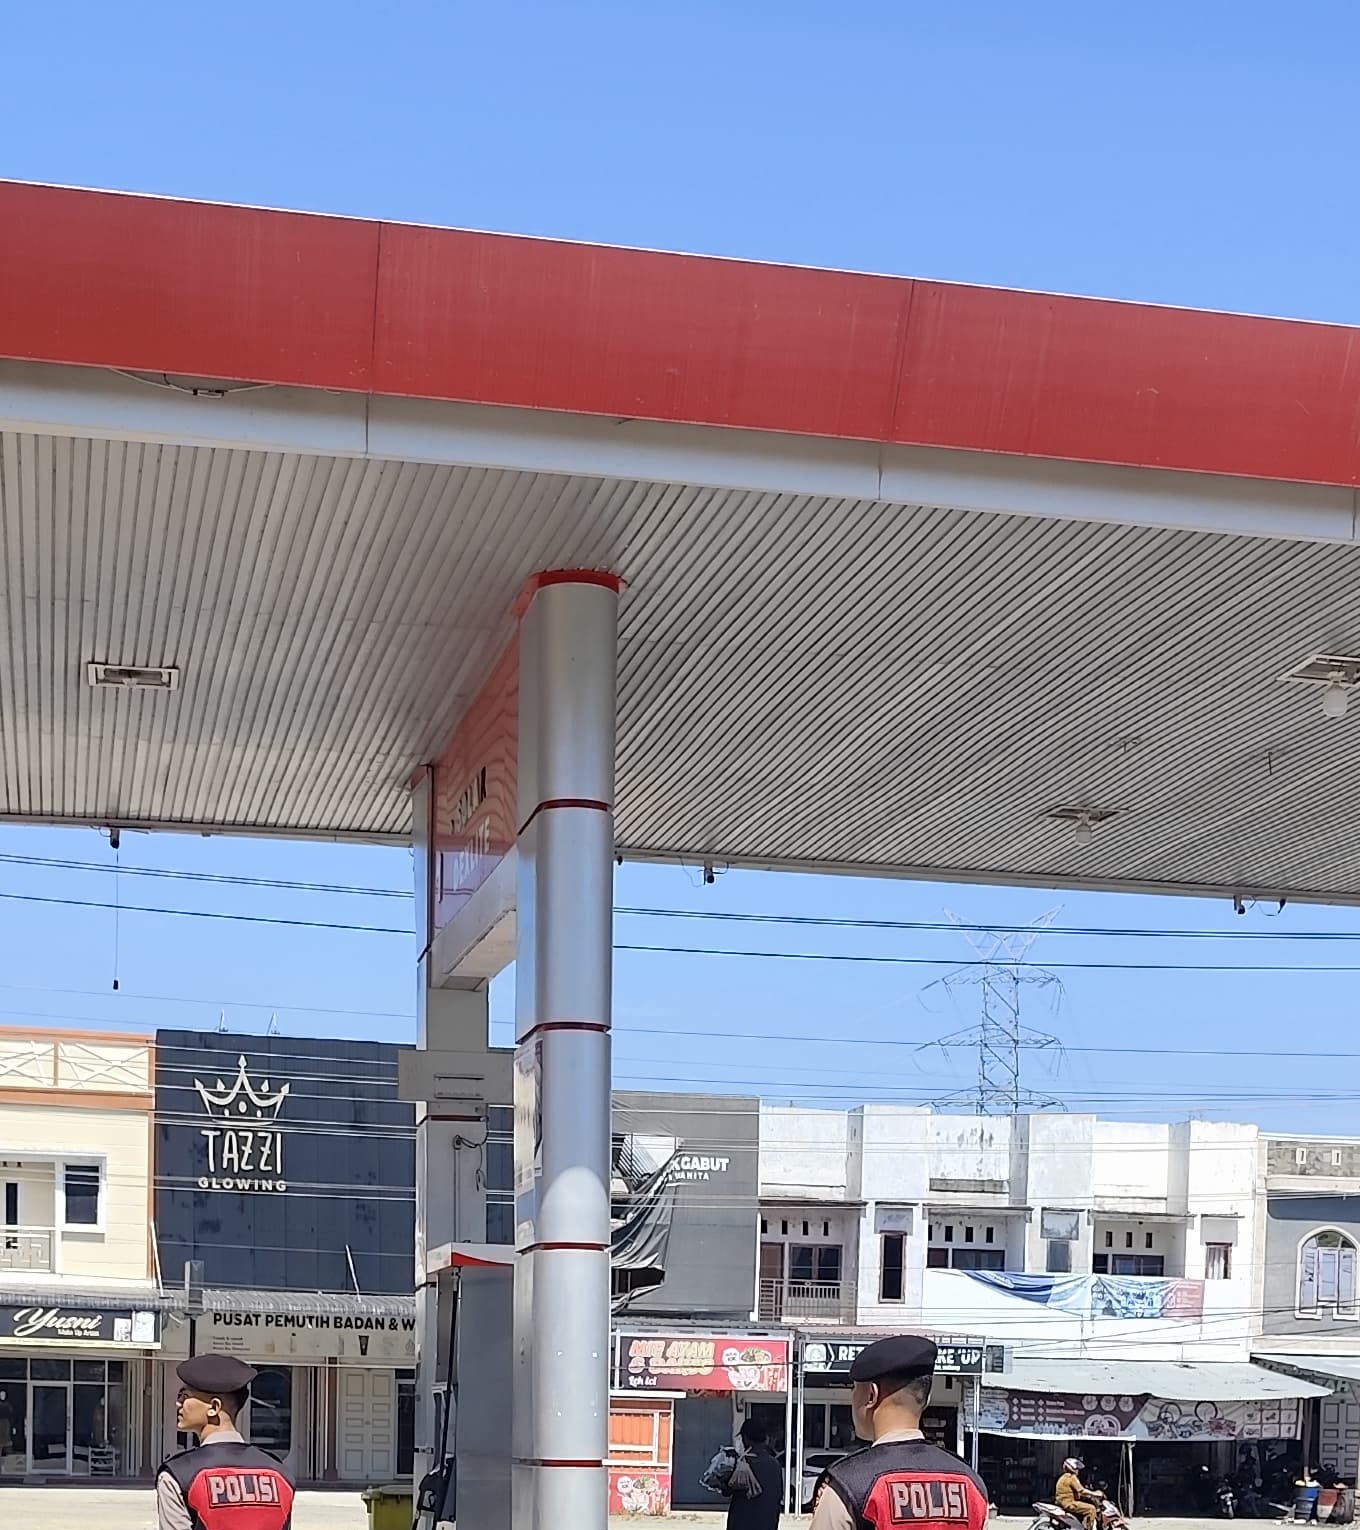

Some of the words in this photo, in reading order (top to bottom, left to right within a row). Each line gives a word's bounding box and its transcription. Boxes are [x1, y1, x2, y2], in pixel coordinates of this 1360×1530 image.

[200, 1130, 282, 1175] TAZZI
[198, 1177, 287, 1192] GLOWING
[12, 1307, 104, 1337] Yusni
[212, 1312, 262, 1327] PUSAT
[265, 1314, 330, 1329] PEMUTIH
[333, 1316, 385, 1330] BADAN
[388, 1317, 399, 1331] &
[666, 1341, 716, 1360] AYAM
[208, 1474, 279, 1504] POLISI
[890, 1481, 968, 1518] POLISI
